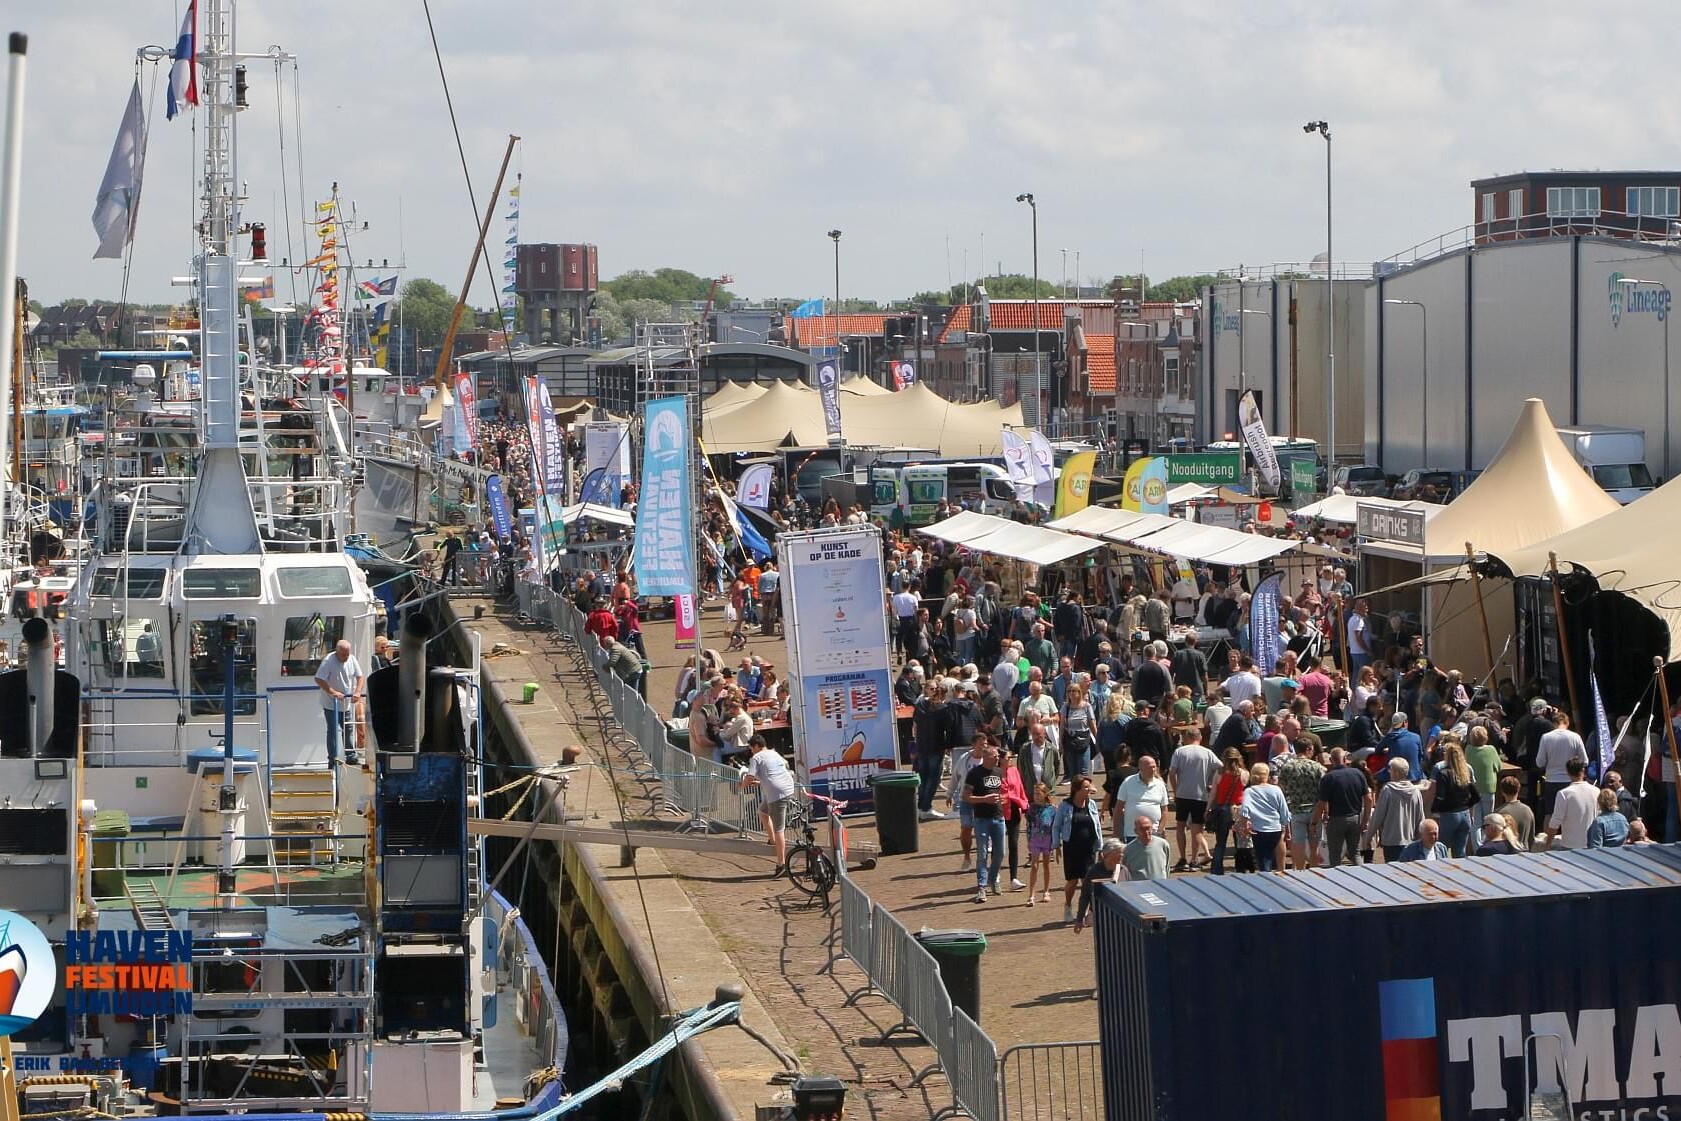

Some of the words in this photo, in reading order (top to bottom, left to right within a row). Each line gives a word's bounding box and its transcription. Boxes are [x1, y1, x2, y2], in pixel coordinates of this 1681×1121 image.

[1626, 285, 1671, 321] Lineage
[1223, 311, 1240, 337] Lineag
[546, 418, 555, 480] HAVEN
[1247, 430, 1268, 469] Airbrush
[1172, 462, 1234, 479] Nooduitgang
[1372, 513, 1408, 537] DRINKS
[810, 553, 822, 561] OP
[824, 552, 836, 560] DE
[838, 549, 862, 559] KADE
[820, 542, 849, 552] KUNST
[825, 673, 866, 683] PROGRAMMA
[826, 762, 879, 780] HAVEN
[827, 778, 871, 791] FESTIV
